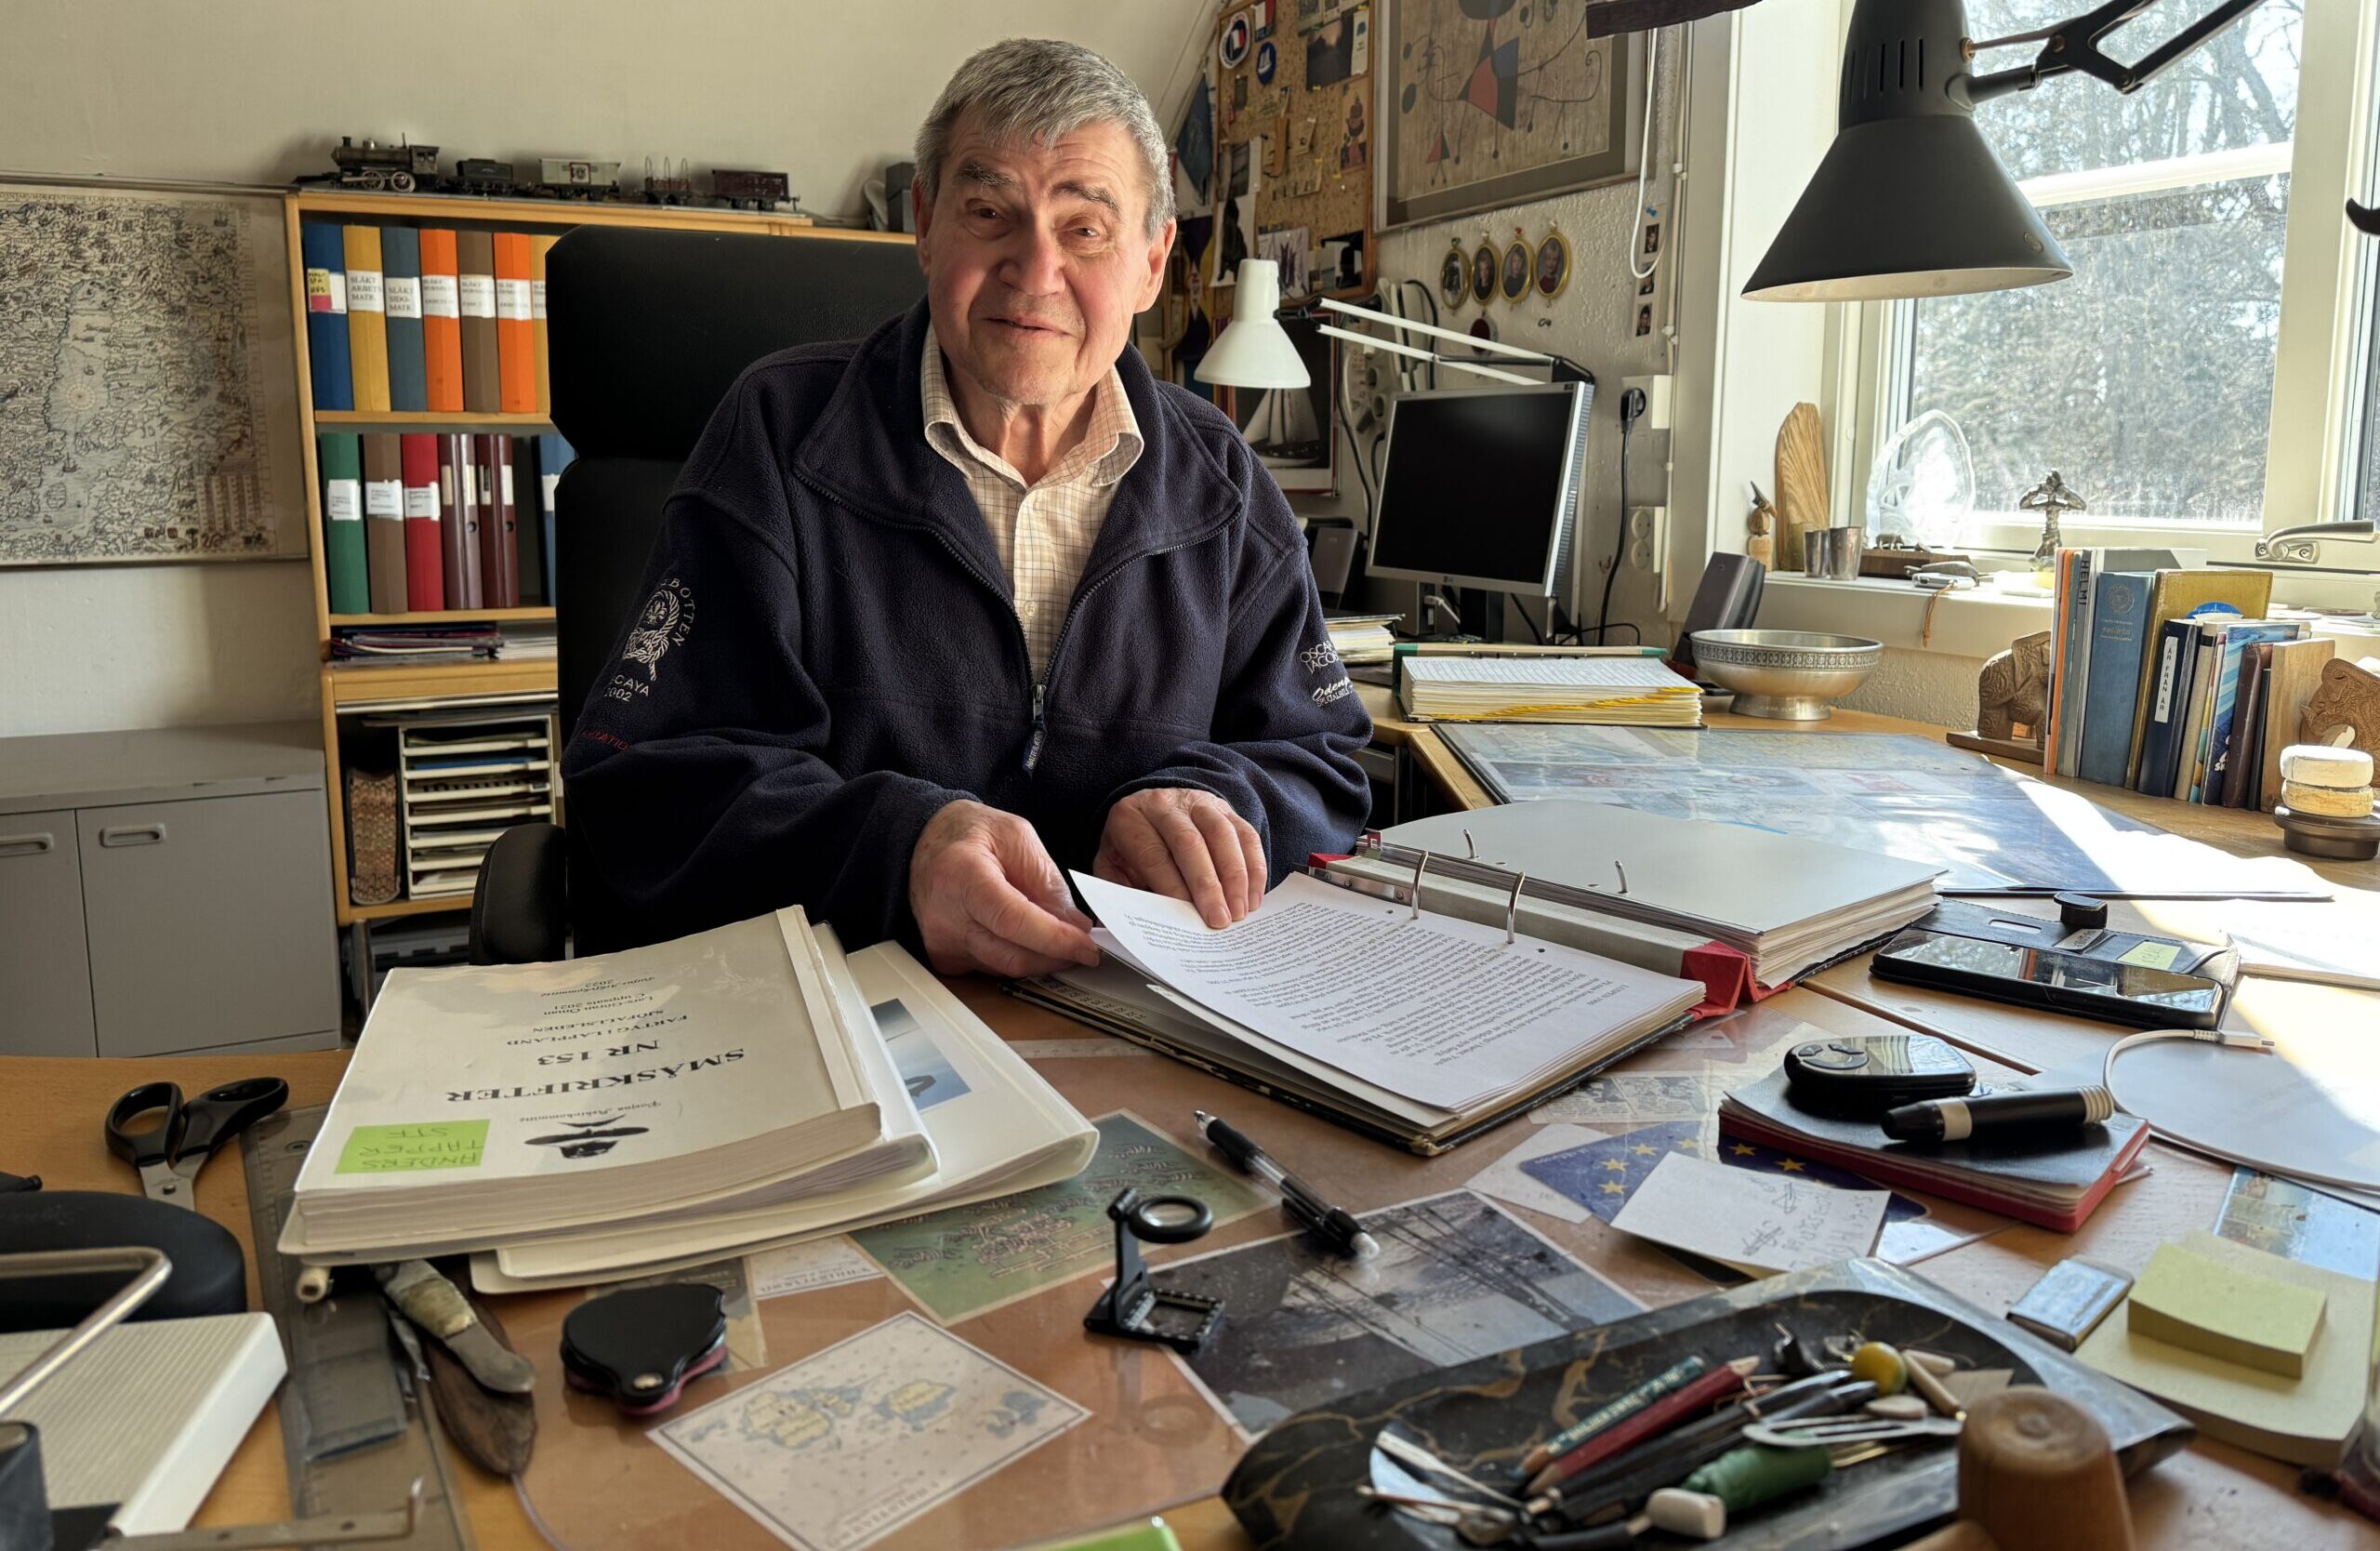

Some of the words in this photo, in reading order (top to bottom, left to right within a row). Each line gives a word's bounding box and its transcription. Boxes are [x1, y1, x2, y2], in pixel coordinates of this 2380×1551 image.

[2078, 560, 2090, 605] HELMI
[609, 673, 650, 697] CAYA
[616, 1014, 687, 1034] FARTYG
[506, 1030, 602, 1046] LAPPLAND
[604, 1039, 660, 1058] NR
[536, 1050, 590, 1067] 153
[445, 1048, 745, 1104] SMÅSKRIFTER
[359, 1139, 484, 1158] TAPPER
[361, 1151, 477, 1170] ANDERS
